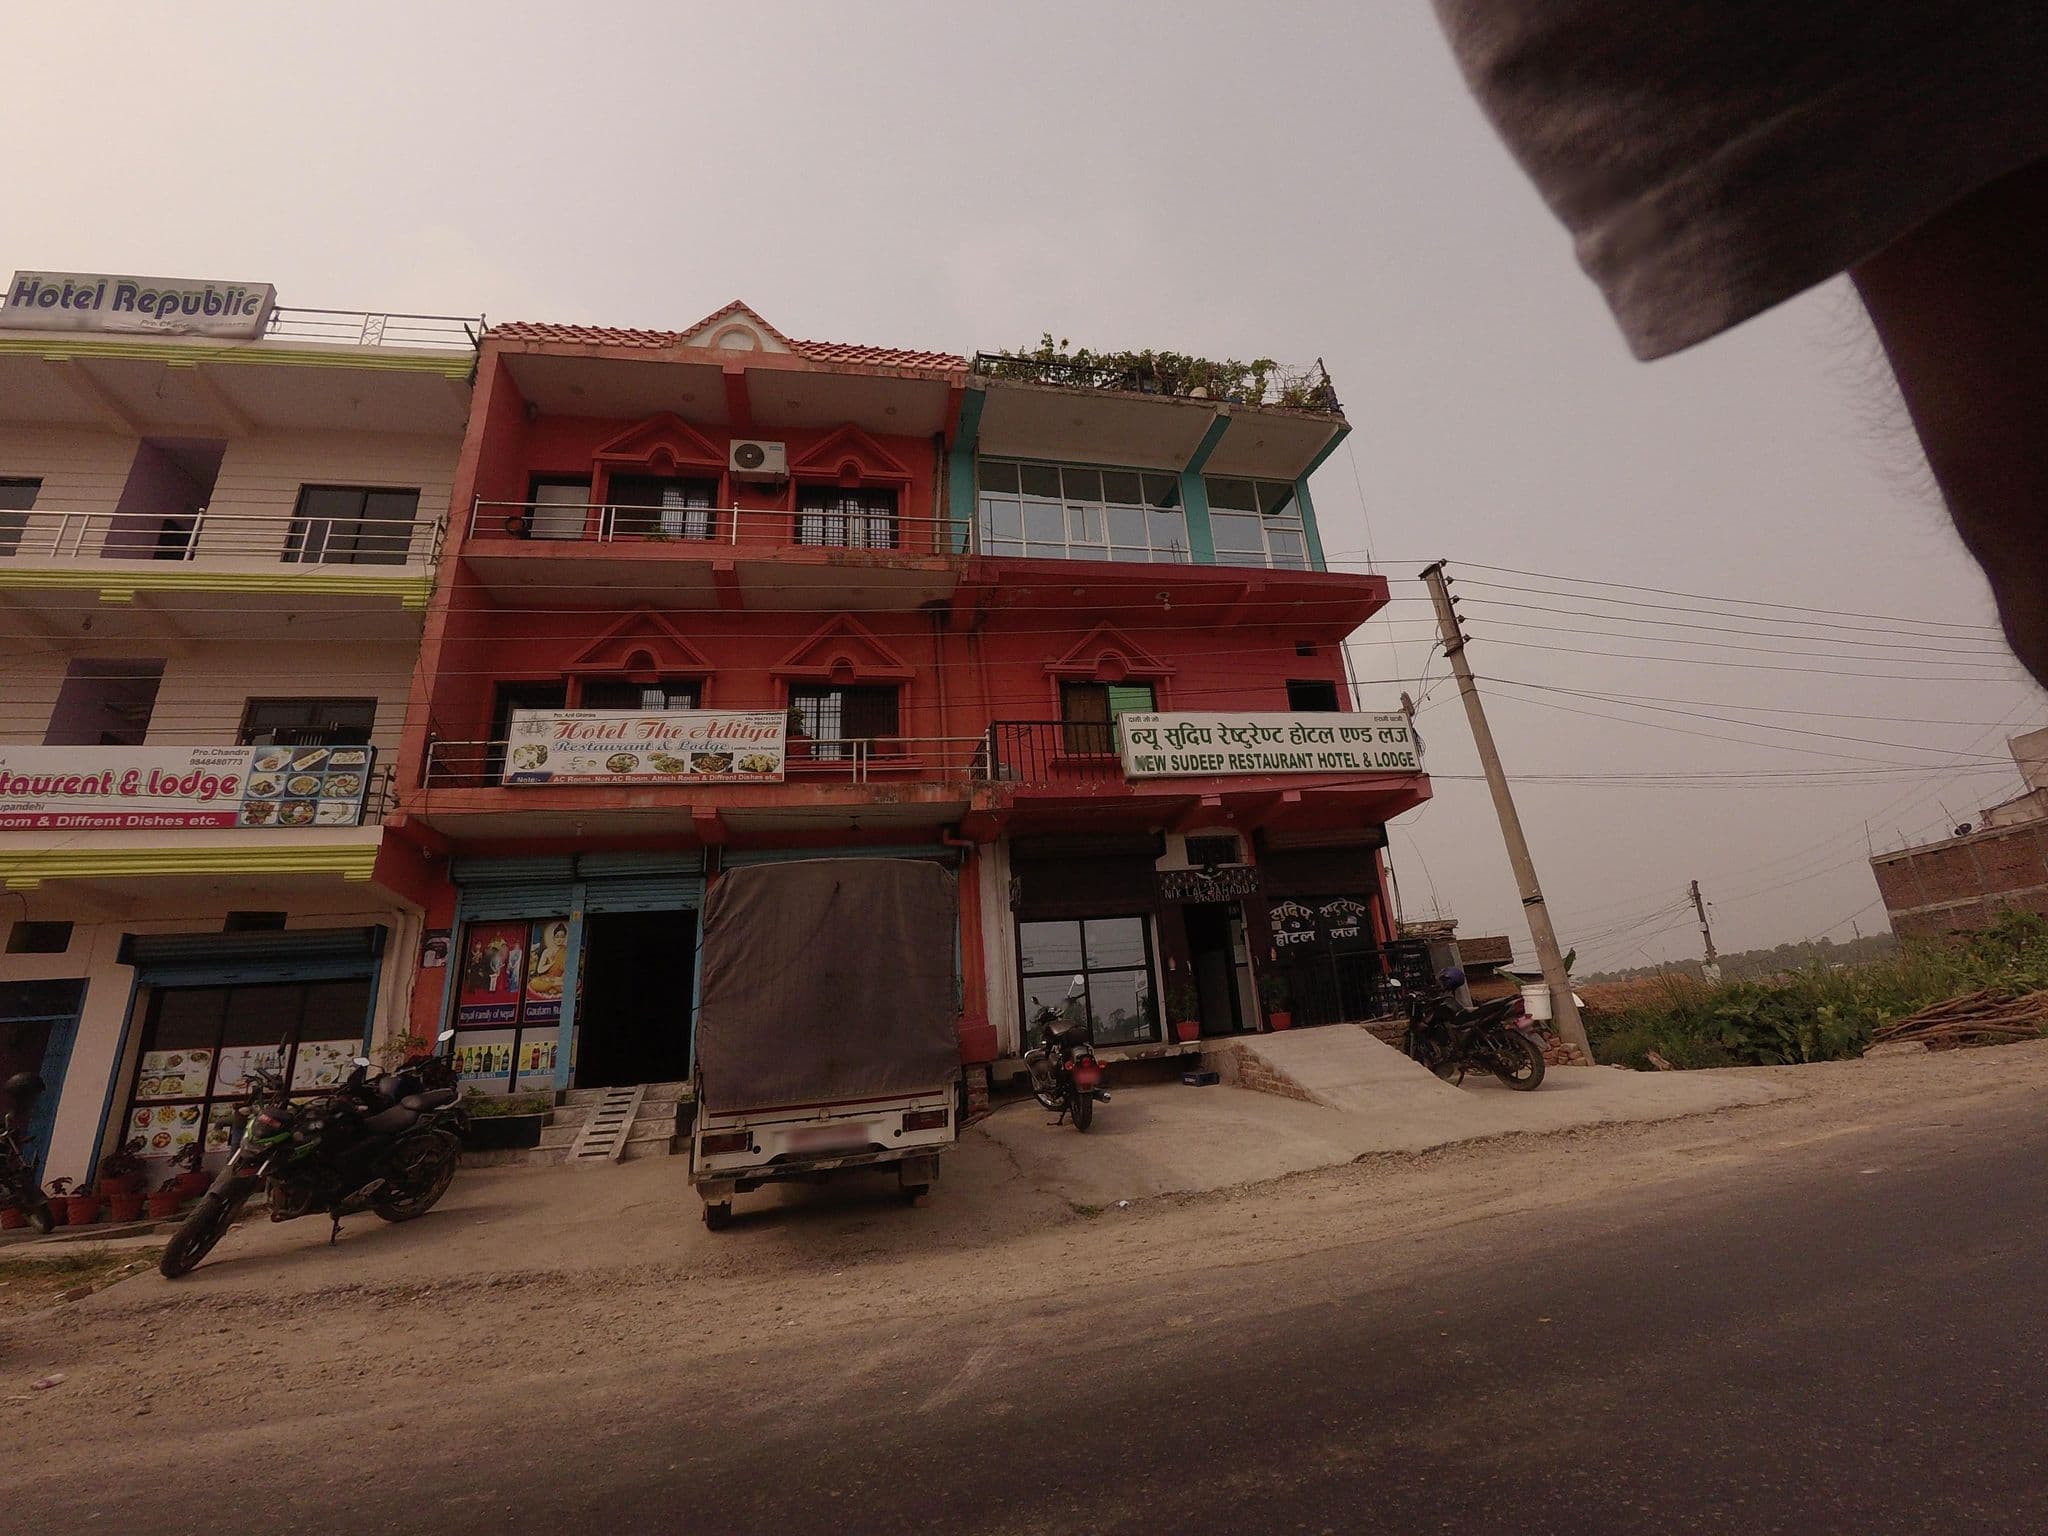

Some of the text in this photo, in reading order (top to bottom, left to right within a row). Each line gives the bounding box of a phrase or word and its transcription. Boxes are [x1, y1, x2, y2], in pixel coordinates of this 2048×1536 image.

[11, 278, 262, 319] Hotel Republic
[553, 719, 781, 743] Hotel The Aditya
[1129, 727, 1162, 750] न्यू
[1164, 722, 1211, 749] सुदिप
[1289, 722, 1335, 744] होटल
[1339, 727, 1373, 744] एण्ड
[1377, 727, 1409, 744] लज
[552, 740, 653, 752] Restaurant
[654, 741, 671, 752] &
[678, 740, 729, 753] Lodge
[1134, 751, 1415, 772] NEW SUDEEP RESTAURANT HOTEL & LODGE
[119, 769, 140, 795] &
[148, 769, 239, 801] lodge
[612, 775, 624, 783] AC
[652, 774, 676, 782] Attach
[709, 773, 737, 781] Diffrent
[738, 773, 764, 781] Dishes
[36, 816, 50, 827] &
[56, 815, 123, 827] Diffrent
[126, 815, 184, 826] Dishes
[189, 815, 220, 826] etc.
[1273, 926, 1360, 946] होटल लज
